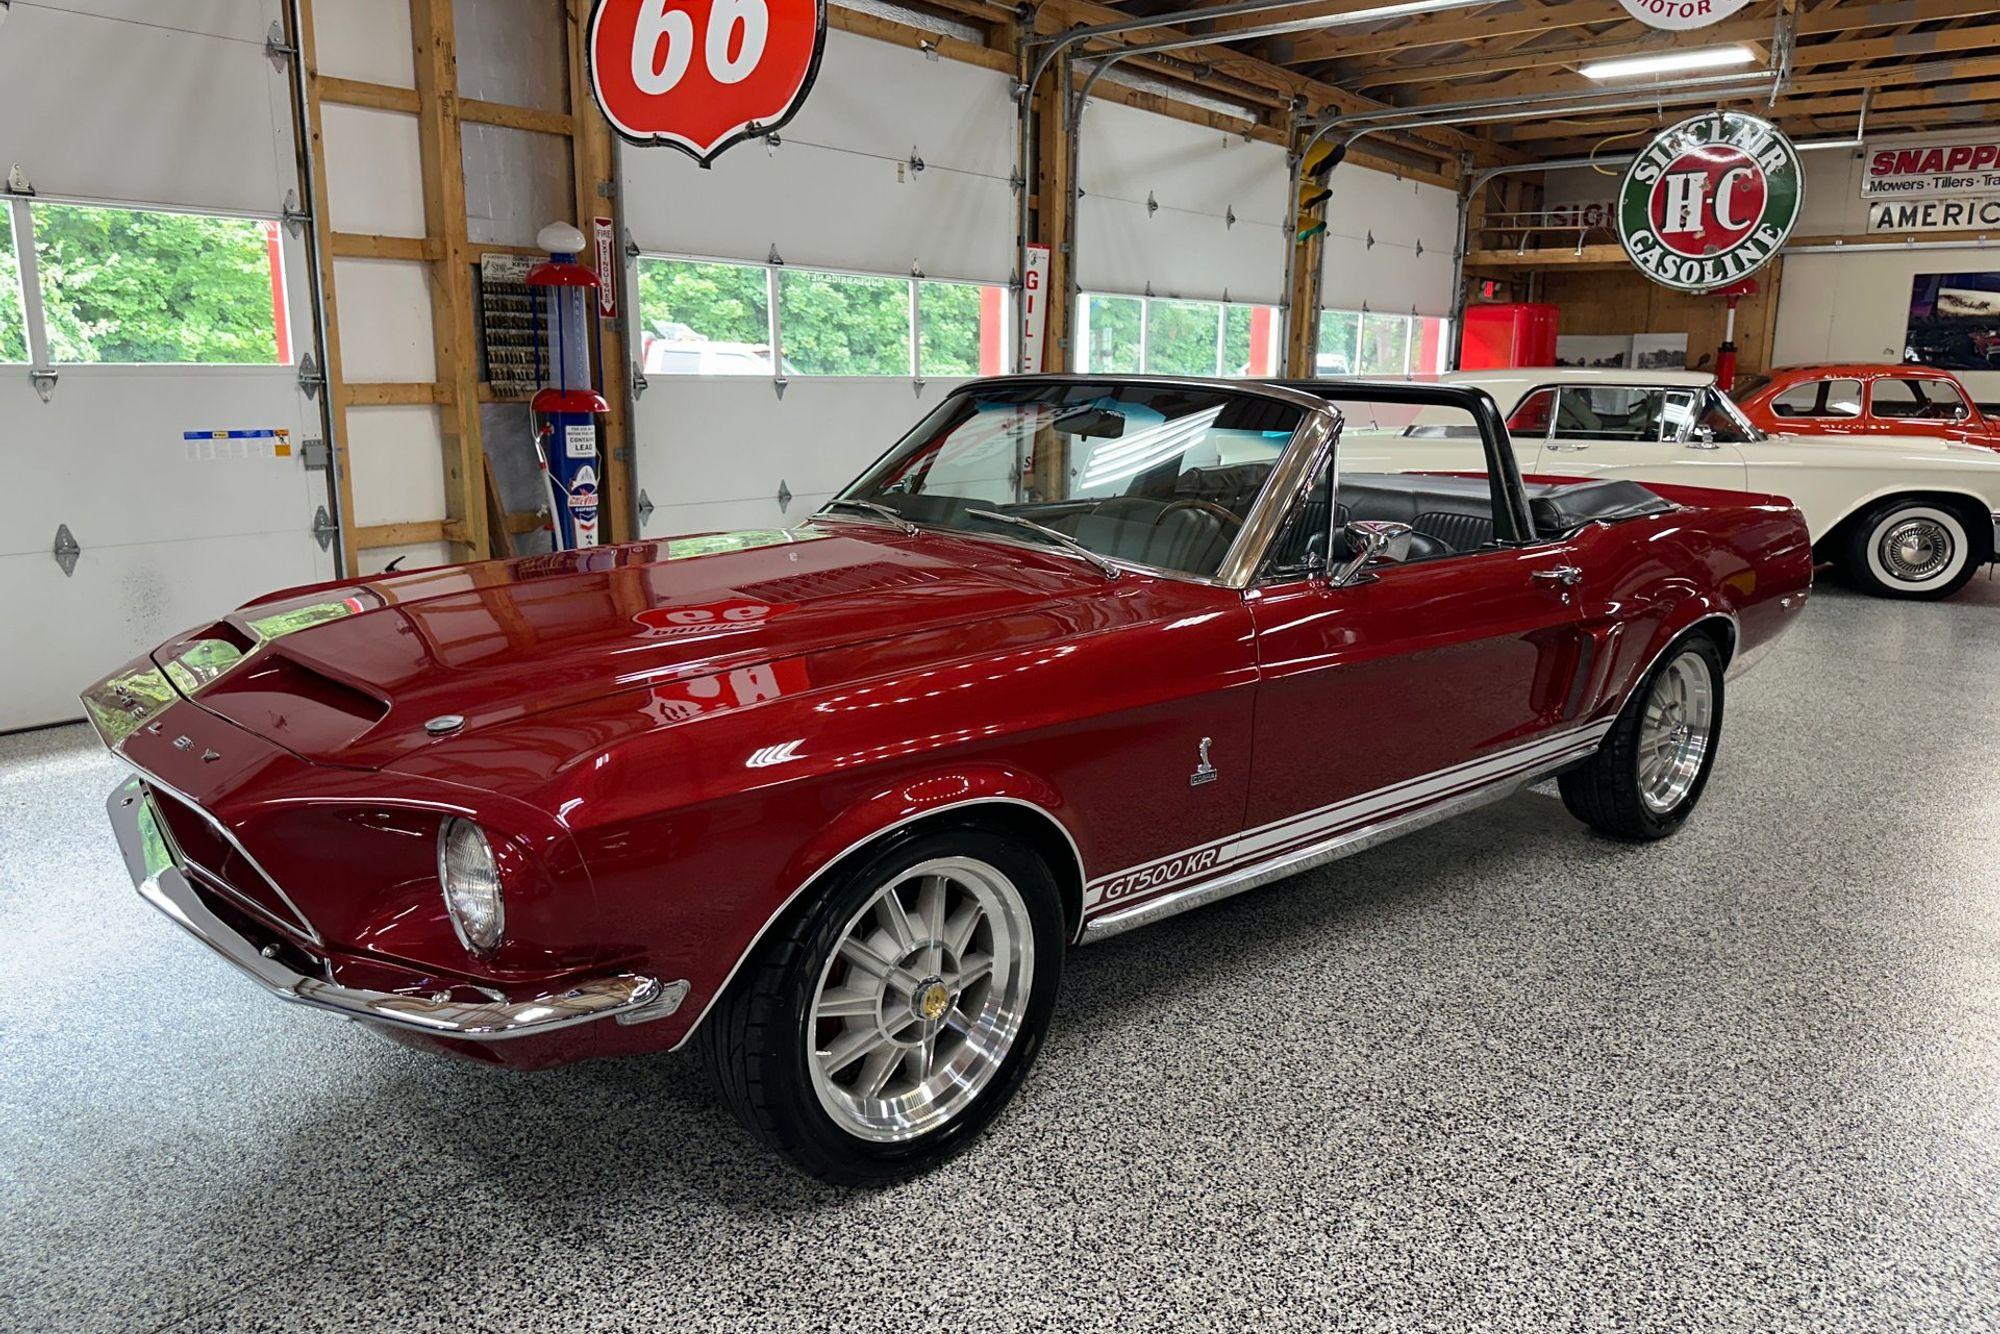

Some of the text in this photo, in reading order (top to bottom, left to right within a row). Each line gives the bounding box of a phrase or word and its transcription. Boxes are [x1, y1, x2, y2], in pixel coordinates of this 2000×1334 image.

[631, 0, 769, 96] 66
[1634, 118, 1788, 185] SINCLAIR
[1870, 145, 2000, 176] SNAPP
[1869, 179, 1925, 192] Mowers
[1932, 176, 1974, 189] Tillers
[597, 229, 611, 238] FIRE
[1629, 222, 1783, 285] GASOLINE
[601, 240, 611, 304] EXTINGUISHER
